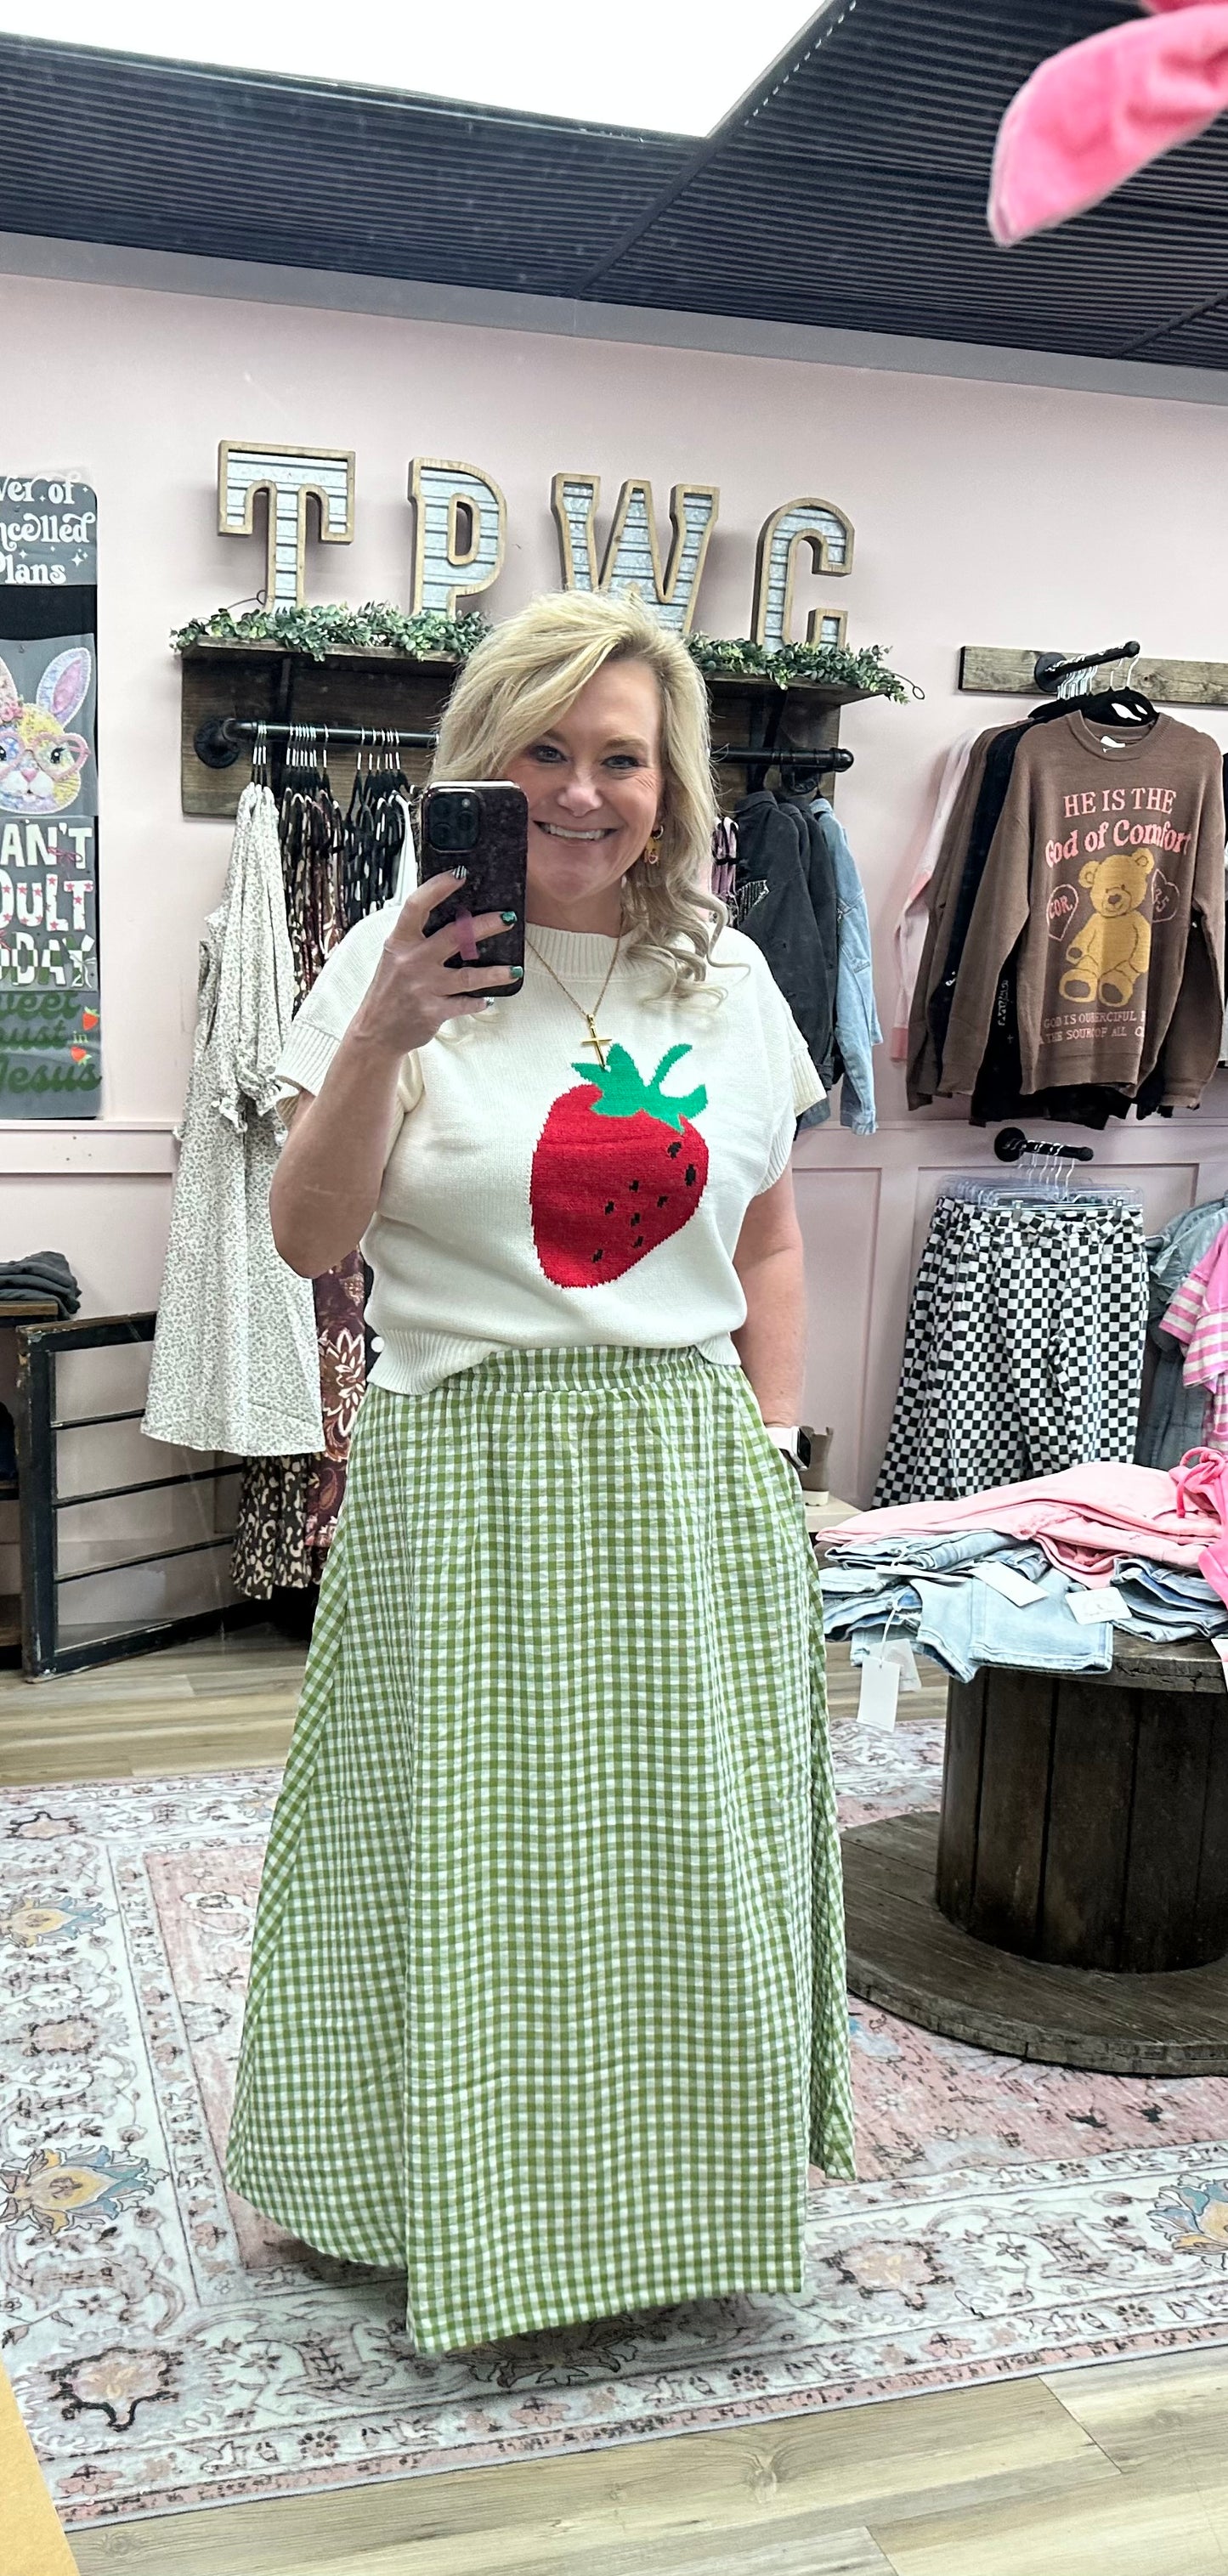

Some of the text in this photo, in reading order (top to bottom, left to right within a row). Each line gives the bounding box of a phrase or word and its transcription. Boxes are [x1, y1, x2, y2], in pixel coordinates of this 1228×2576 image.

[1063, 787, 1177, 818] HE IS THE
[1044, 829, 1079, 868] God
[1084, 821, 1110, 852] of
[1064, 1013, 1077, 1025] IS
[72, 1030, 88, 1044] in
